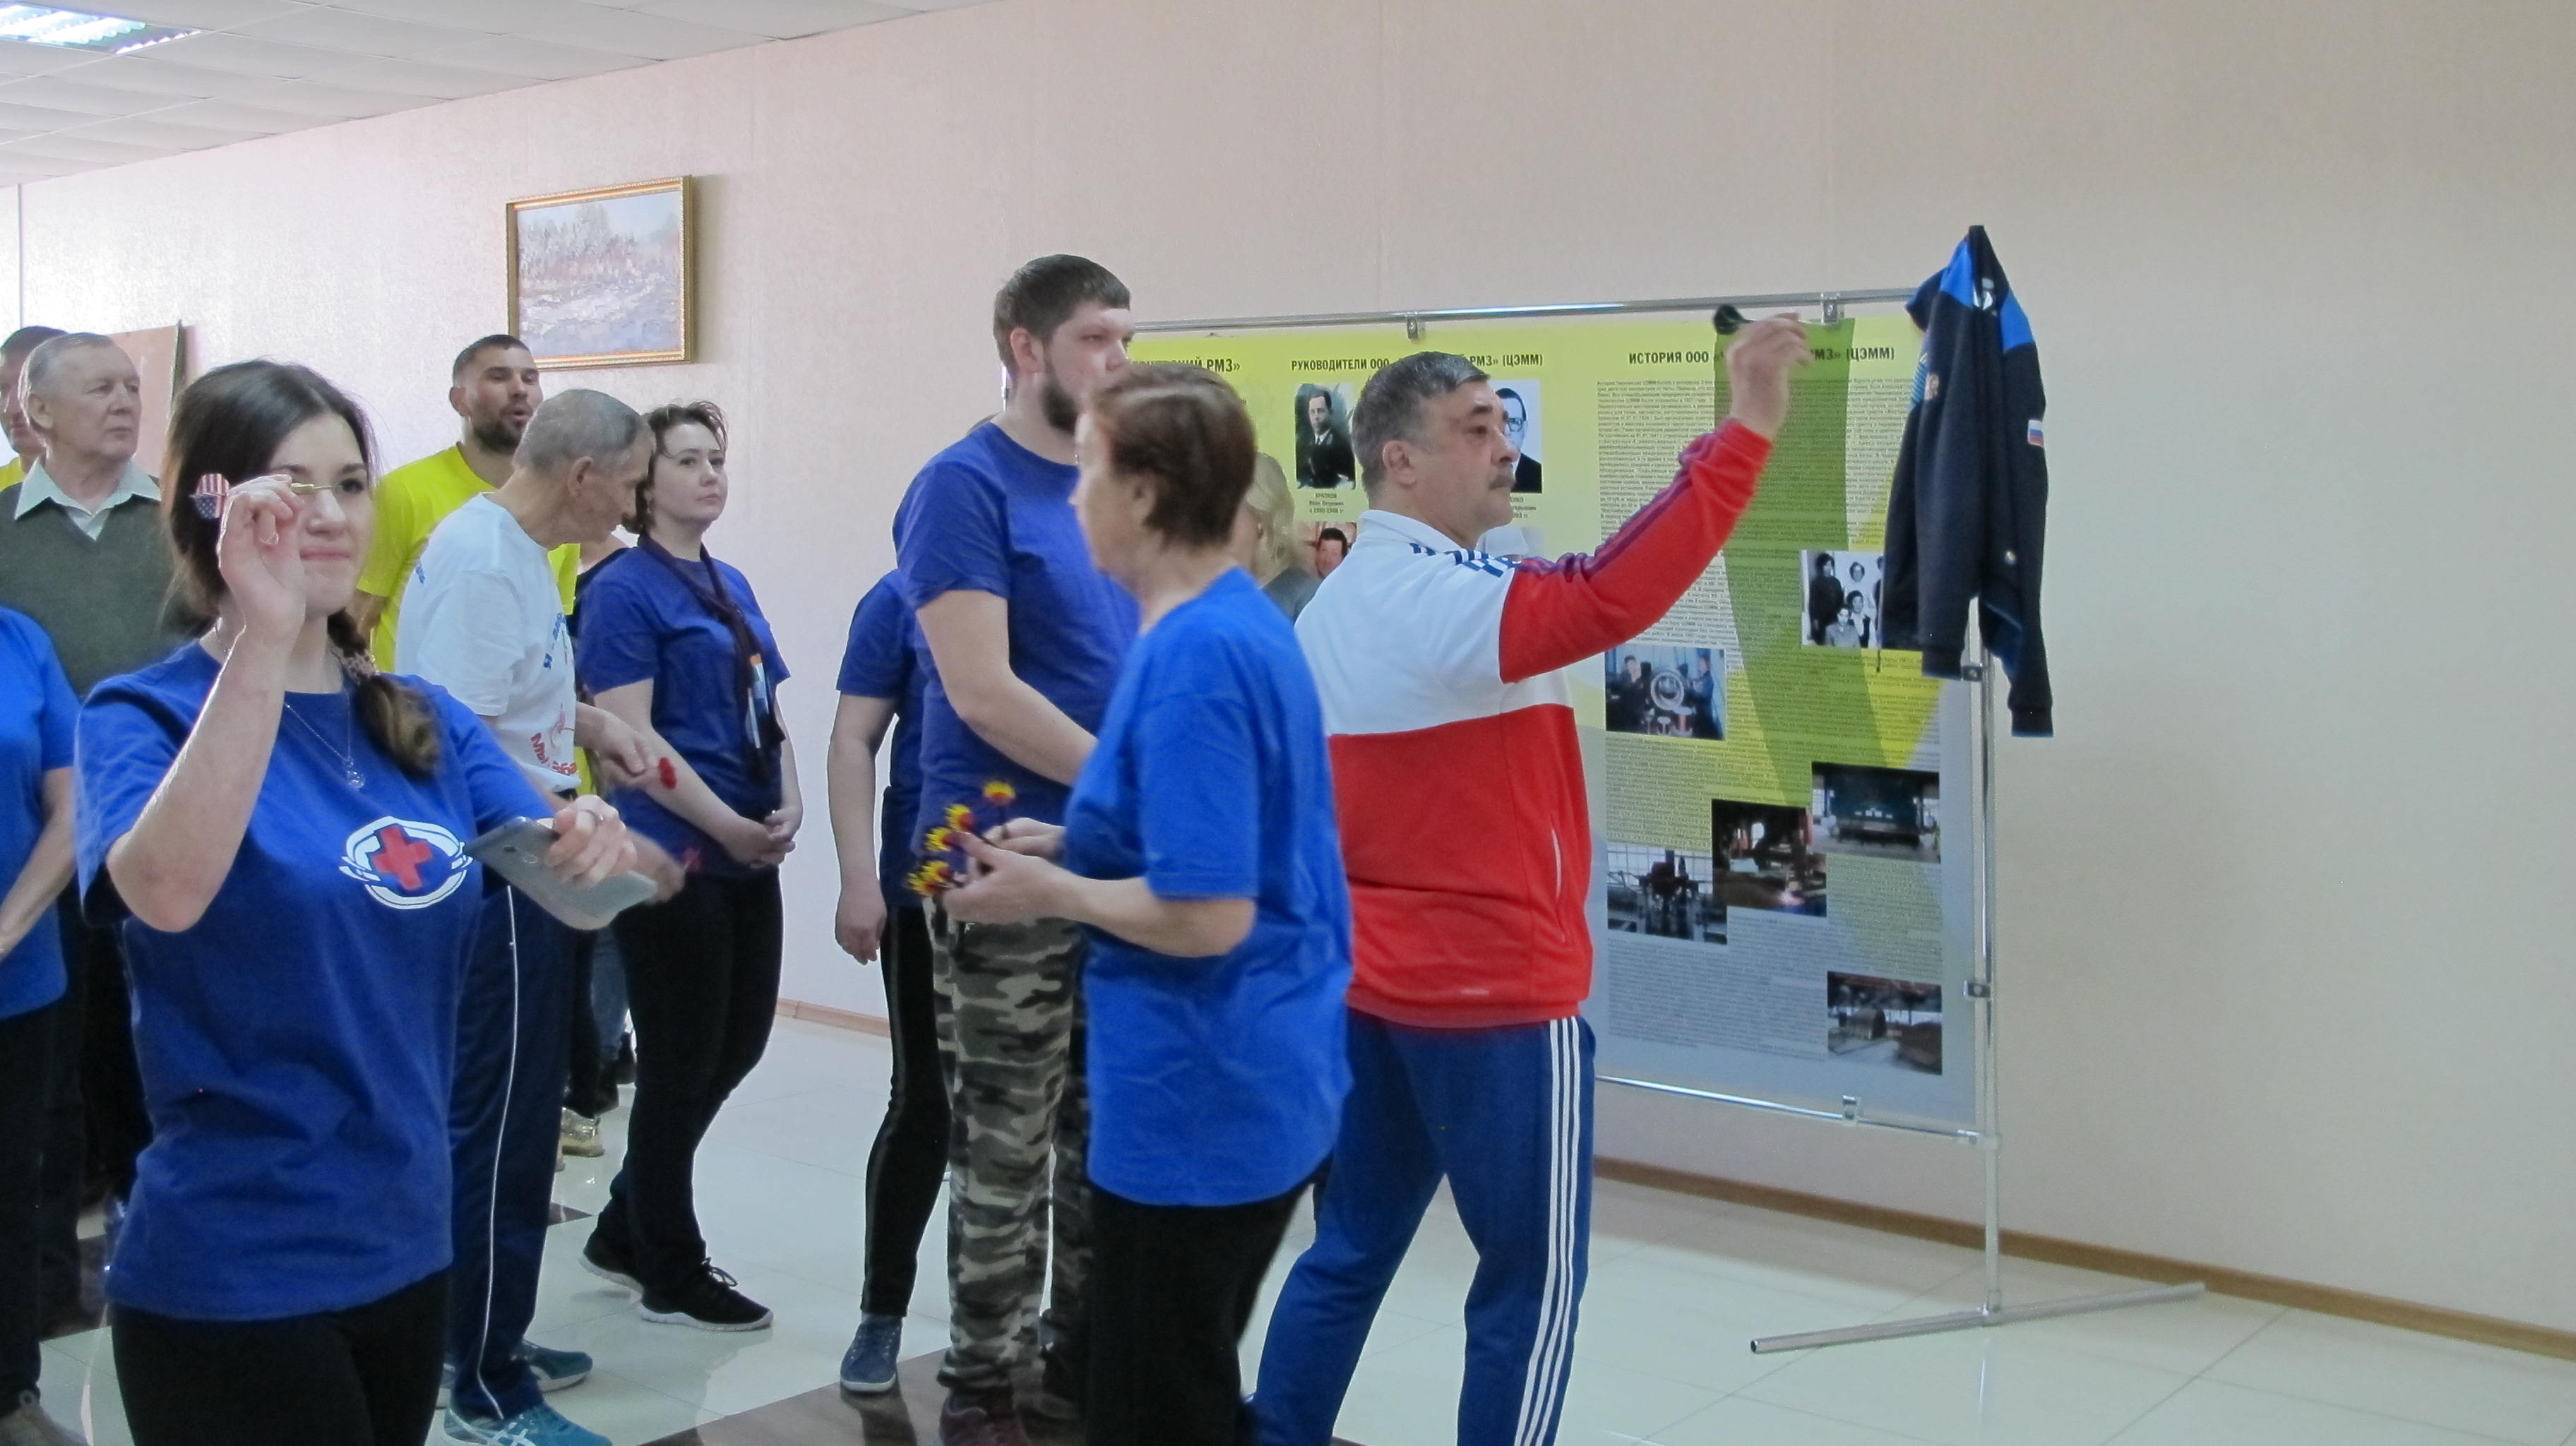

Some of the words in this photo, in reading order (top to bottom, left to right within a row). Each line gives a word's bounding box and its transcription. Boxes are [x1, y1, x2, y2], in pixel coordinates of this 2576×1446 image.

[1291, 358, 1367, 371] РУКОВОДИТЕЛИ
[1502, 354, 1543, 367] (ЦЭММ)
[1628, 352, 1682, 364] ИСТОРИЯ
[1686, 351, 1710, 363] ООО
[1810, 348, 1841, 361] МЗ»
[1846, 347, 1895, 362] (ЦЭММ)
[1206, 358, 1241, 373] РМЗ»
